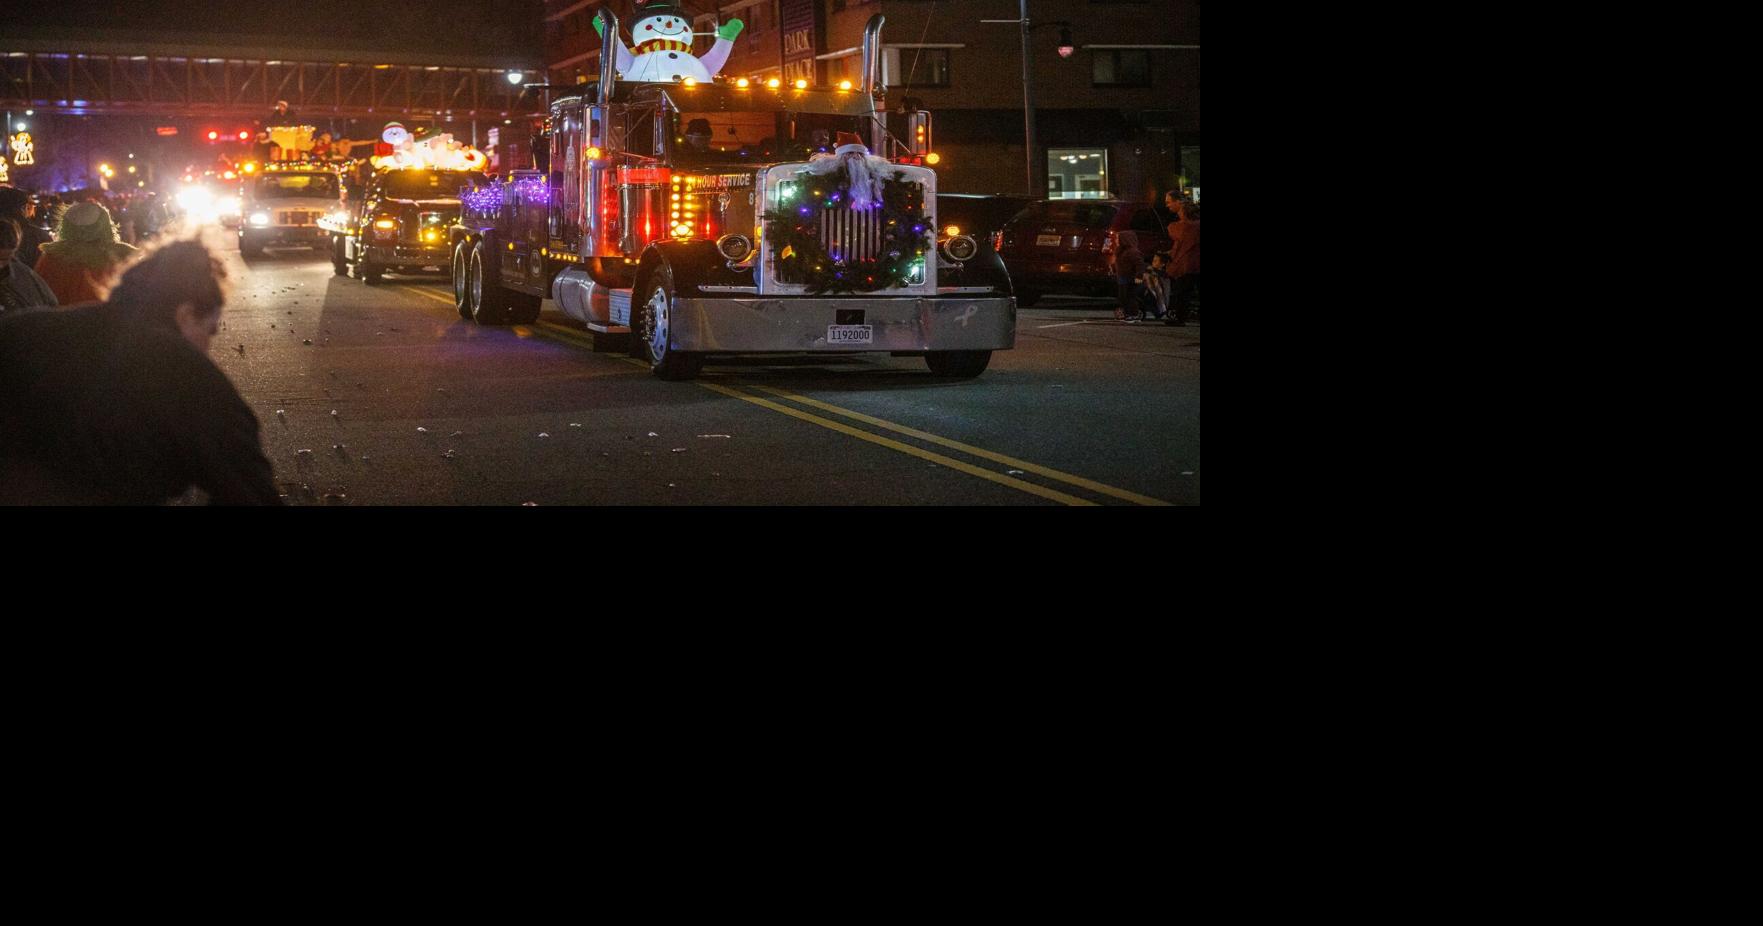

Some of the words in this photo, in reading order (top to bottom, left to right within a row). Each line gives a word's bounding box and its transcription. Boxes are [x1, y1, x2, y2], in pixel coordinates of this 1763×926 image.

[784, 29, 809, 54] PARK
[696, 174, 717, 189] HOUR
[718, 173, 750, 187] SERVICE
[831, 330, 870, 340] 1192000
